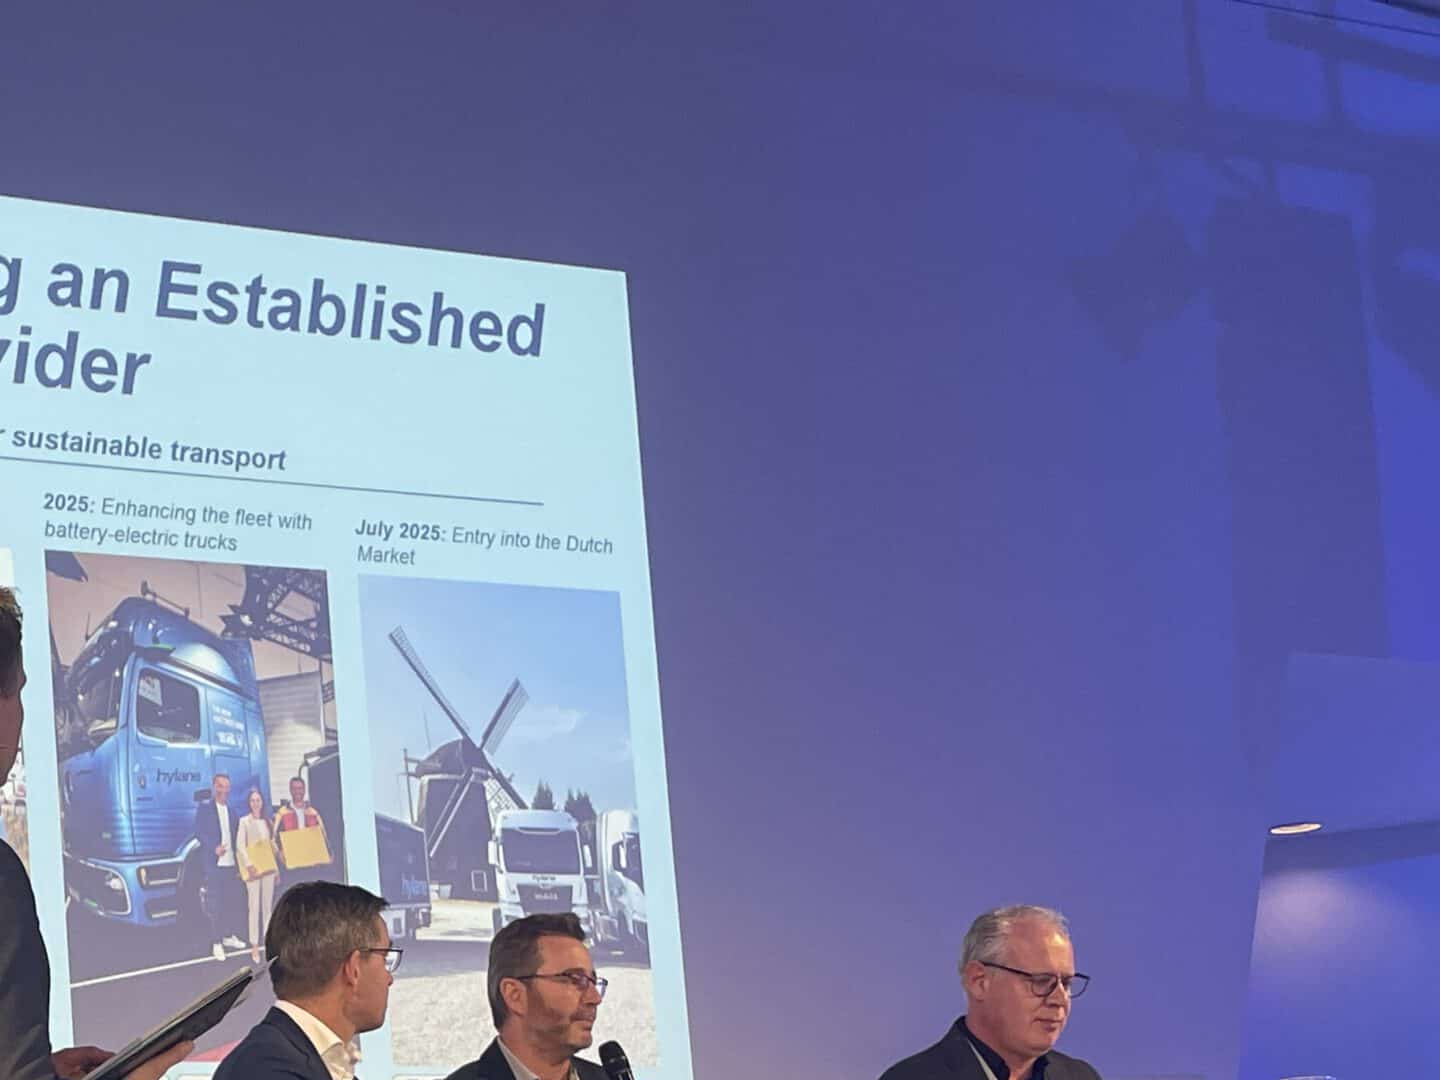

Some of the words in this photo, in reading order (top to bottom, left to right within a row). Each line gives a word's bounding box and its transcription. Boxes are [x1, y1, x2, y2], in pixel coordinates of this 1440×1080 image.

[46, 262, 130, 314] an
[154, 259, 546, 358] Established
[11, 429, 163, 460] sustainable
[170, 440, 287, 473] transport
[42, 492, 96, 515] 2025:
[101, 497, 197, 527] Enhancing
[202, 505, 230, 525] the
[235, 508, 273, 529] fleet
[278, 513, 313, 531] with
[44, 519, 180, 547] battery-electric
[183, 530, 238, 552] trucks
[354, 519, 395, 542] July
[399, 522, 447, 542] 2025:
[451, 525, 497, 550] Entry
[500, 532, 531, 549] into
[535, 532, 561, 550] the
[565, 535, 613, 554] Dutch
[357, 544, 416, 566] Market
